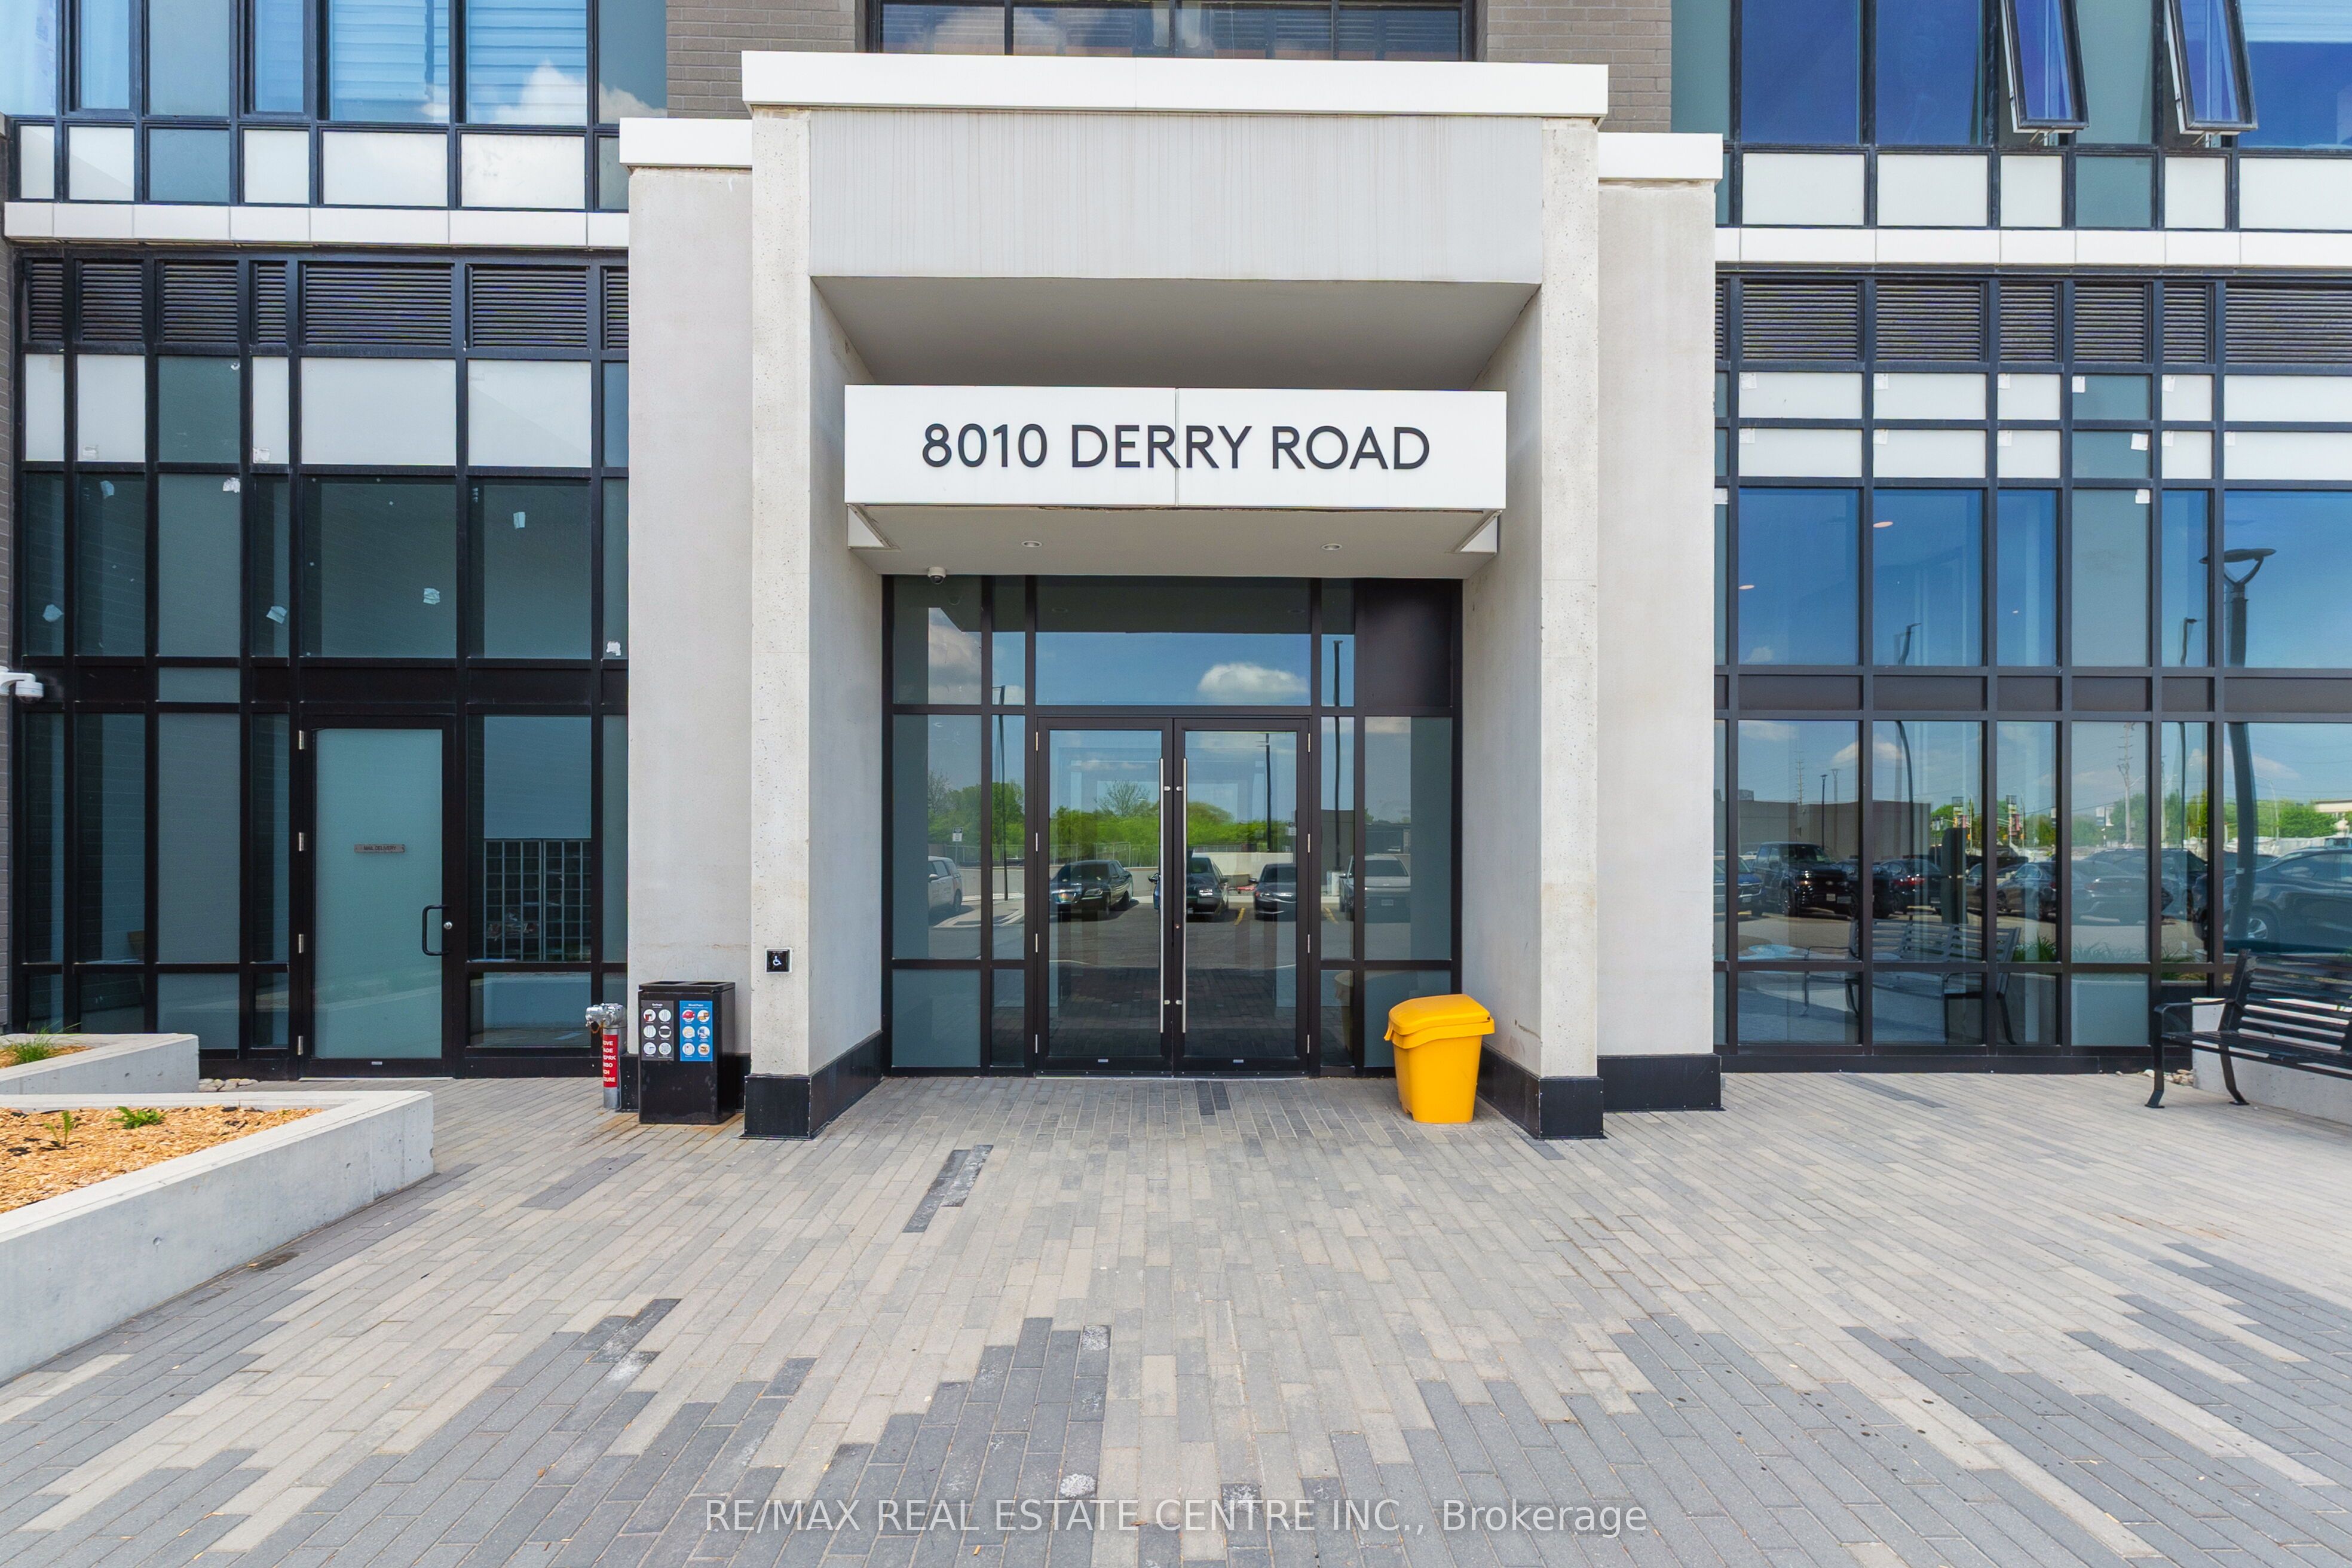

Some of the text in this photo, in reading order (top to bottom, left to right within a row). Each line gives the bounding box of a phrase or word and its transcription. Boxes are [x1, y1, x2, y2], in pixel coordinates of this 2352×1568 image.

[922, 423, 1430, 470] 8010 DERRY ROAD
